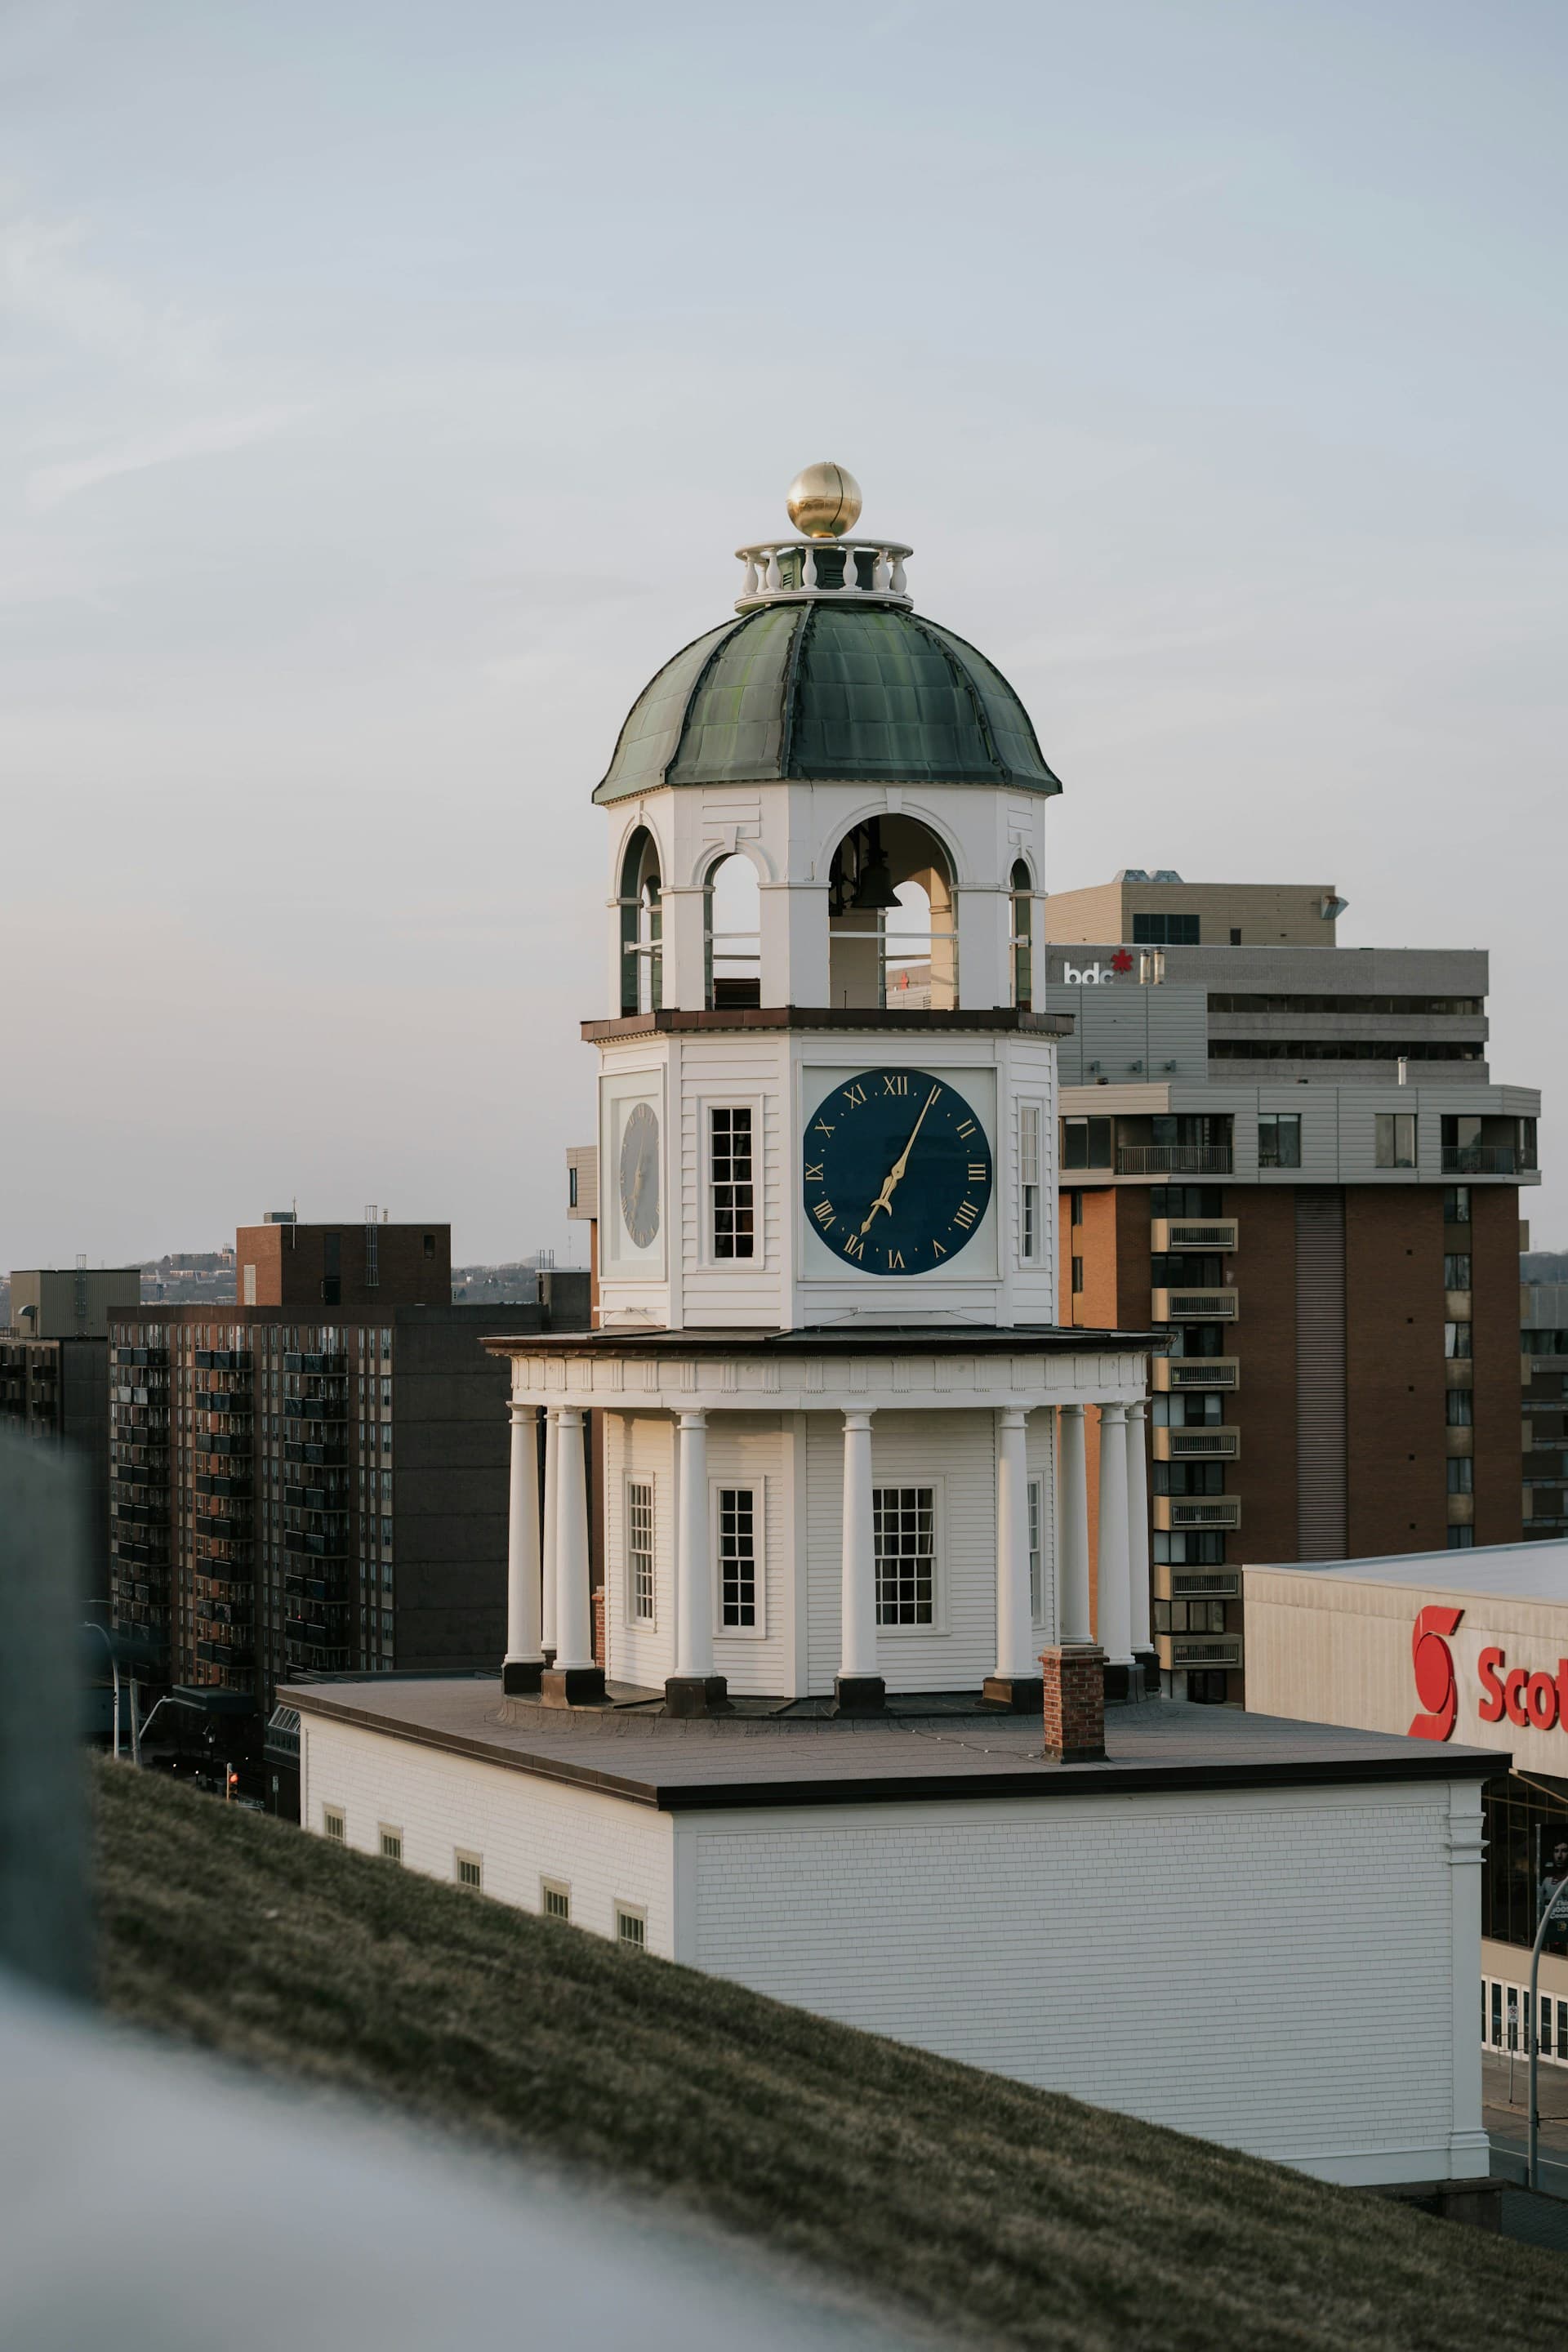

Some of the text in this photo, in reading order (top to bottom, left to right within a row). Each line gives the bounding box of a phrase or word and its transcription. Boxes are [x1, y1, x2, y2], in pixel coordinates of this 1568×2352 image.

[1063, 962, 1115, 984] bdc
[884, 1076, 908, 1095] XII
[843, 1084, 867, 1109] XI
[814, 1118, 835, 1138] X
[956, 1119, 977, 1139] II
[805, 1163, 823, 1181] IX
[968, 1163, 986, 1181] III
[813, 1200, 837, 1231] VIII
[953, 1200, 979, 1230] IIII
[844, 1234, 864, 1261] VII
[933, 1240, 947, 1258] V
[889, 1250, 906, 1268] VI
